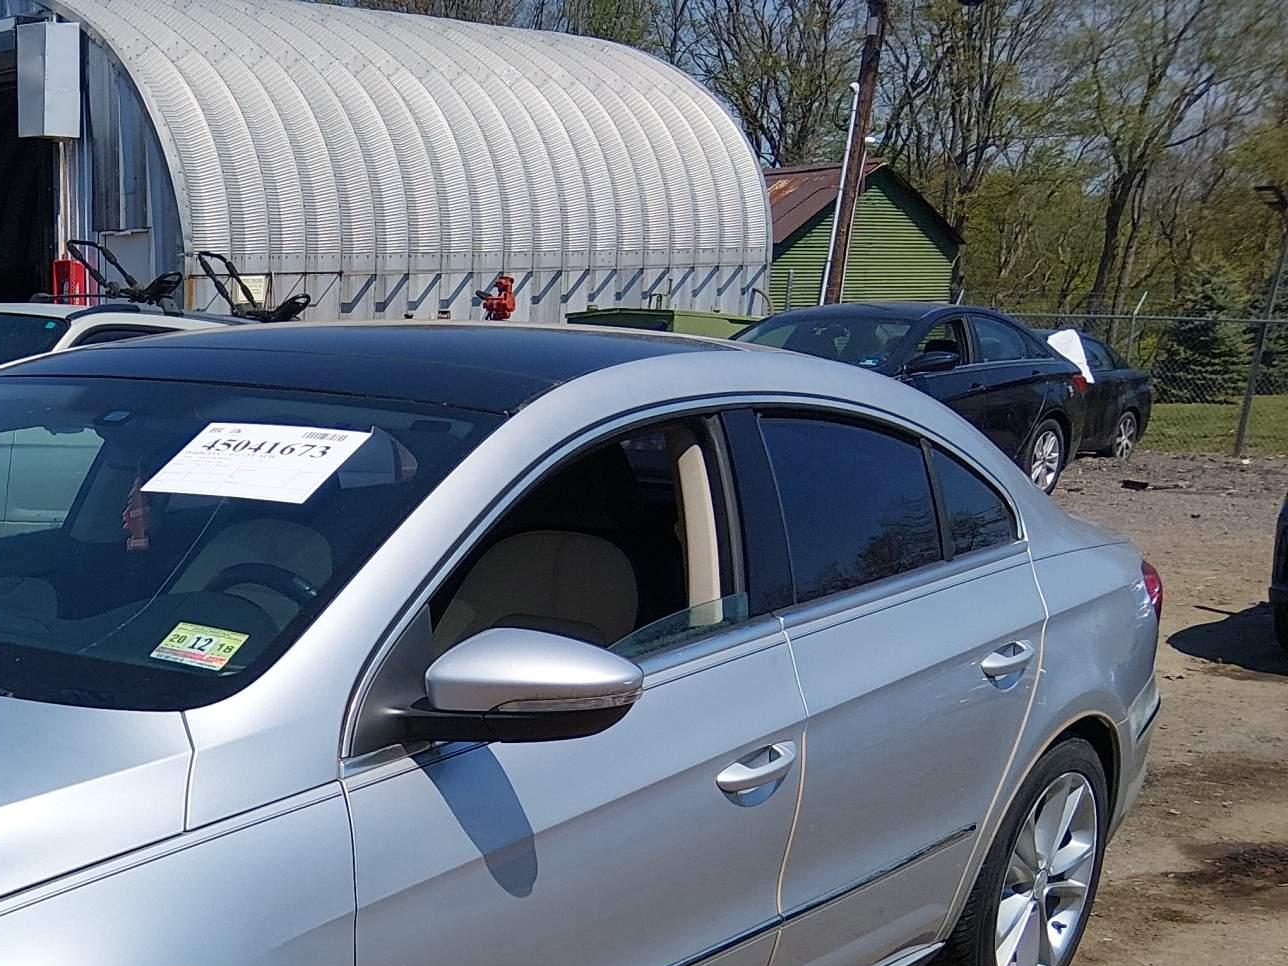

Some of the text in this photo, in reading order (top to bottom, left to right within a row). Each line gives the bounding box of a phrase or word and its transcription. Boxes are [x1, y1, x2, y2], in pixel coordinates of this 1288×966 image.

[202, 438, 331, 458] 45041673
[169, 633, 234, 654] 20 12 18
